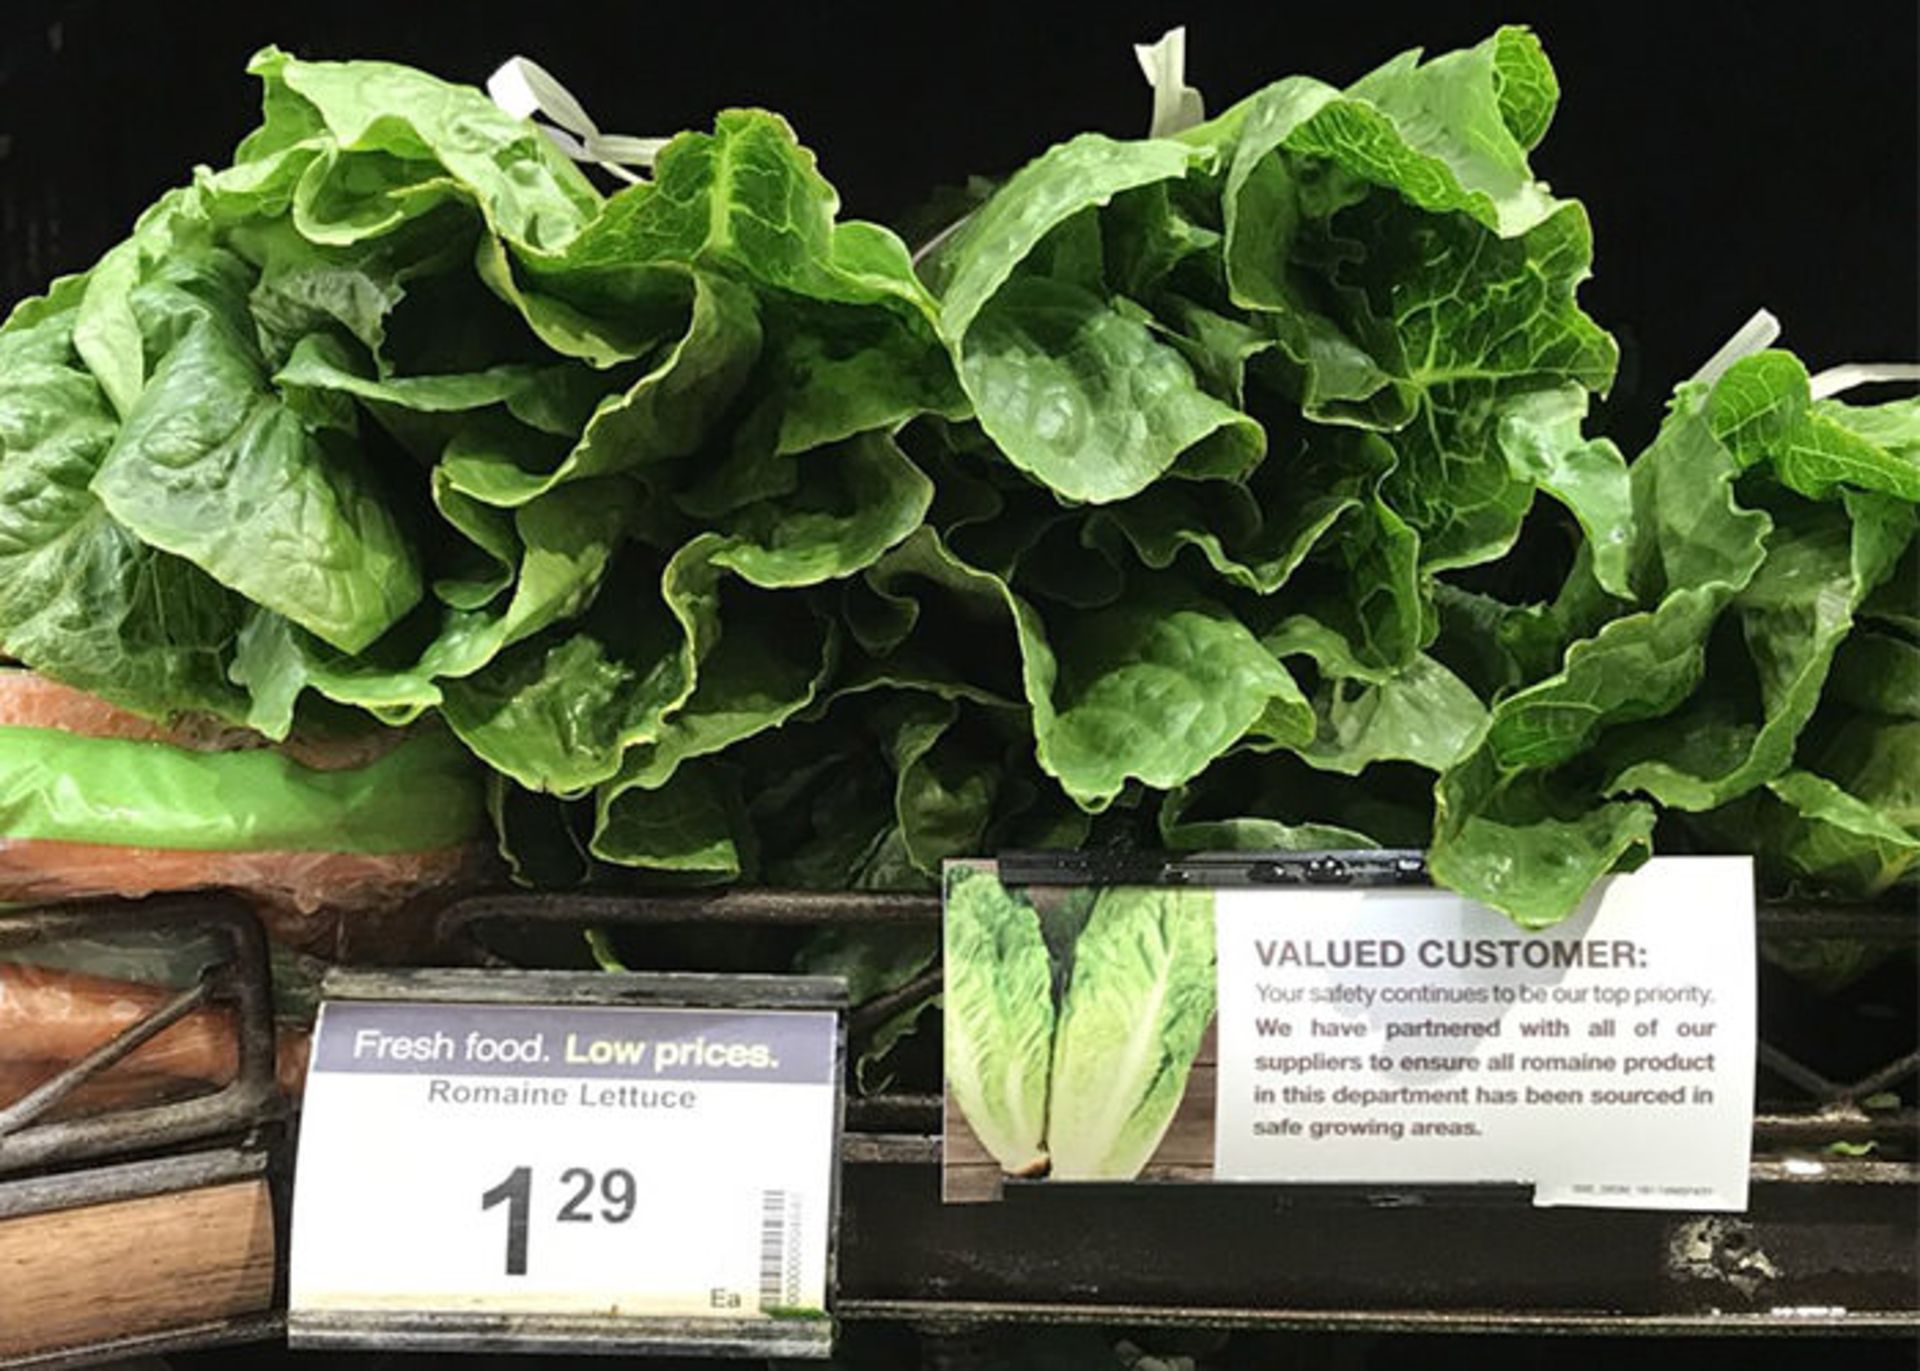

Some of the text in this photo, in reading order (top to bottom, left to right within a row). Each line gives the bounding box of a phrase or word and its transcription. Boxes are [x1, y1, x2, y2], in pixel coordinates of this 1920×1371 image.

[1254, 939, 1648, 969] VALUED CUSTOMER:
[1255, 983, 1715, 1006] Your safety continues to be our top priority.
[1255, 1019, 1716, 1041] We have partnered with all of our
[354, 1029, 779, 1071] Fresh food. Low prices.
[1255, 1053, 1715, 1075] suppliers to ensure all romaine product
[429, 1080, 696, 1109] Romaine Lettuce
[1255, 1086, 1714, 1107] in this department has been sourced in
[1254, 1119, 1482, 1141] safe growing areas.
[482, 1167, 637, 1276] 1 29
[710, 1289, 741, 1308] Ea
